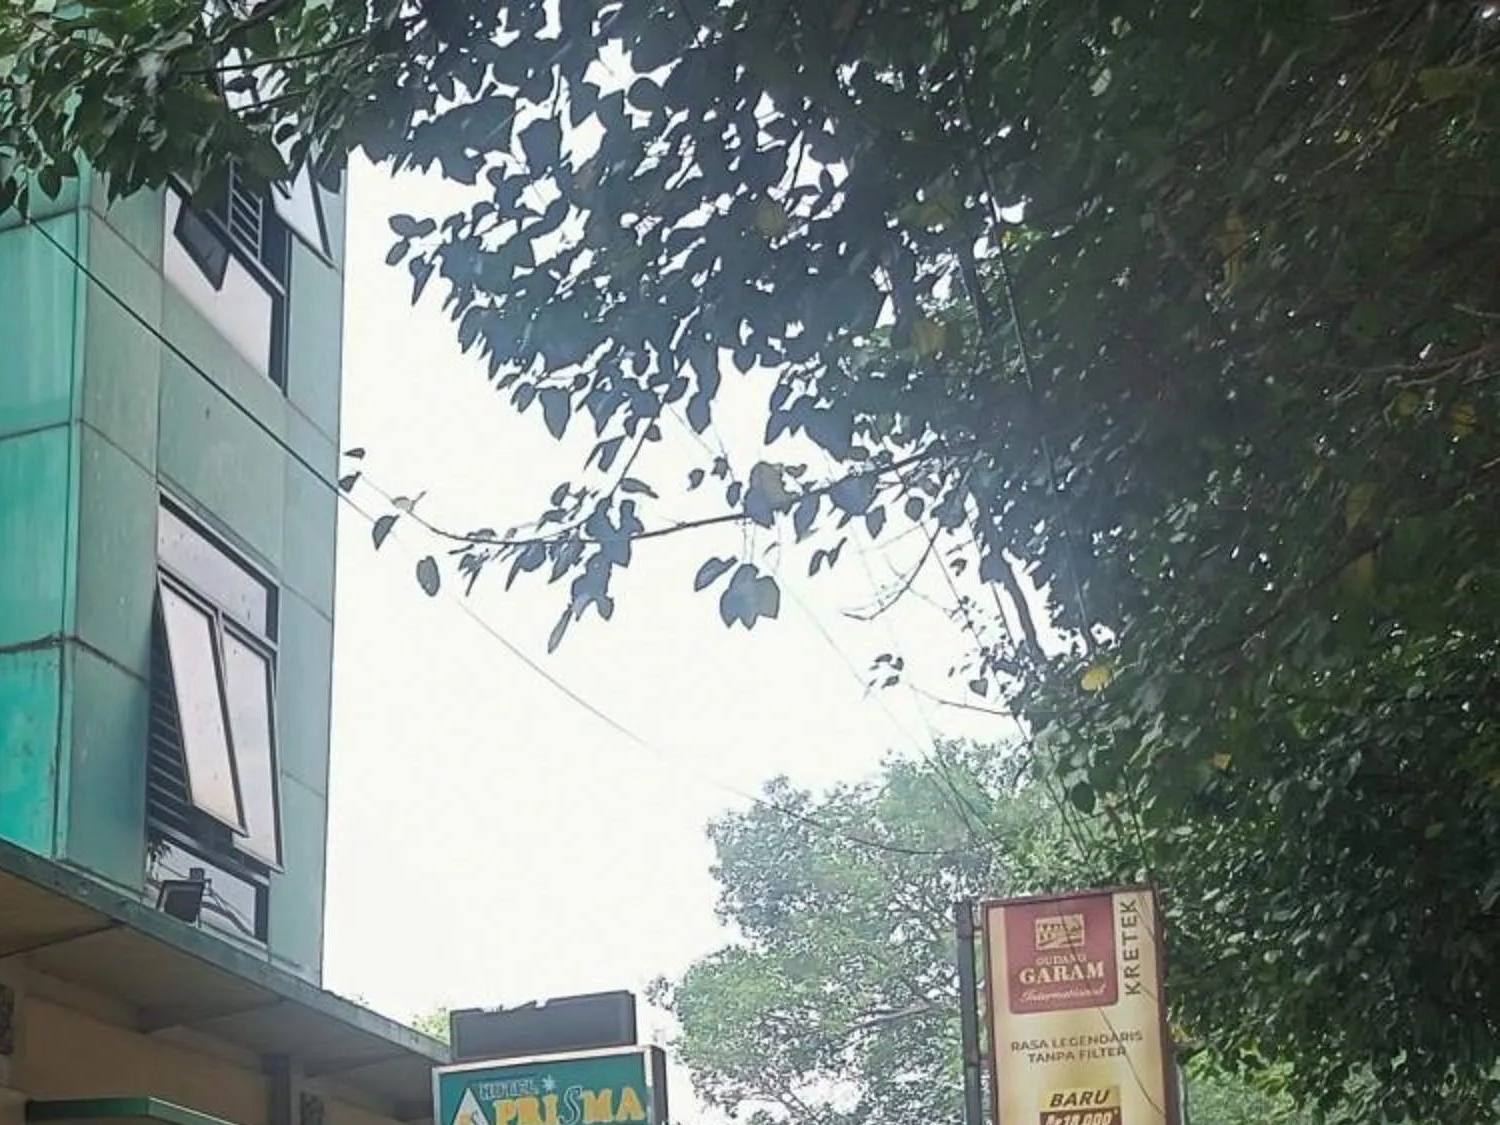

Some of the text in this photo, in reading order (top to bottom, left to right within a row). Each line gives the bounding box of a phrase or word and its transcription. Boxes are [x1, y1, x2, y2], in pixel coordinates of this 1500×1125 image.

[1120, 900, 1141, 996] KRETEK
[1019, 960, 1105, 985] GARAM
[1011, 1030, 1143, 1052] RASA LEGENDARIS
[1027, 1046, 1126, 1063] TANPA FILTER
[1049, 1088, 1111, 1108] BARU
